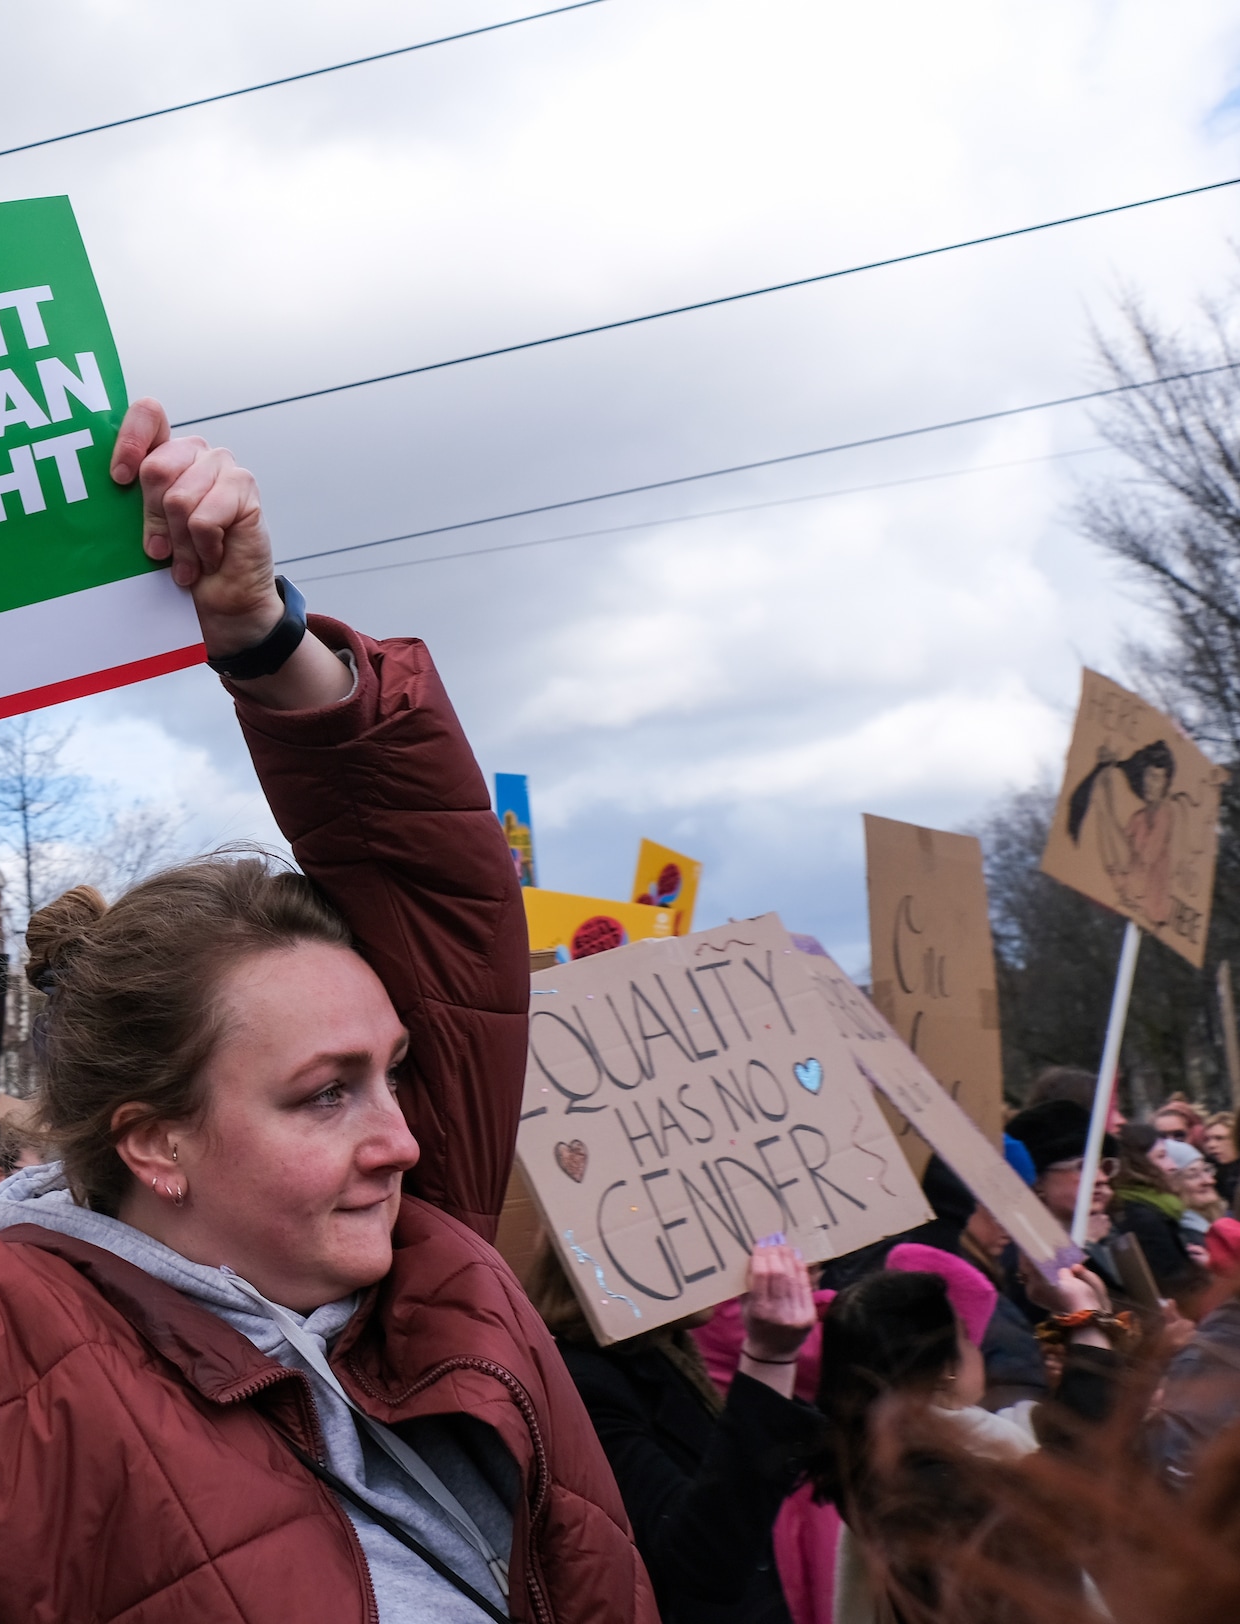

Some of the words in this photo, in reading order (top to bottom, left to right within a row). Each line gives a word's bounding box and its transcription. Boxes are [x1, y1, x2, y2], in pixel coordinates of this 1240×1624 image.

[520, 950, 796, 1121] QUALITY
[614, 1083, 715, 1167] HAS
[710, 1059, 789, 1132] NO
[597, 1124, 867, 1301] GENDER
